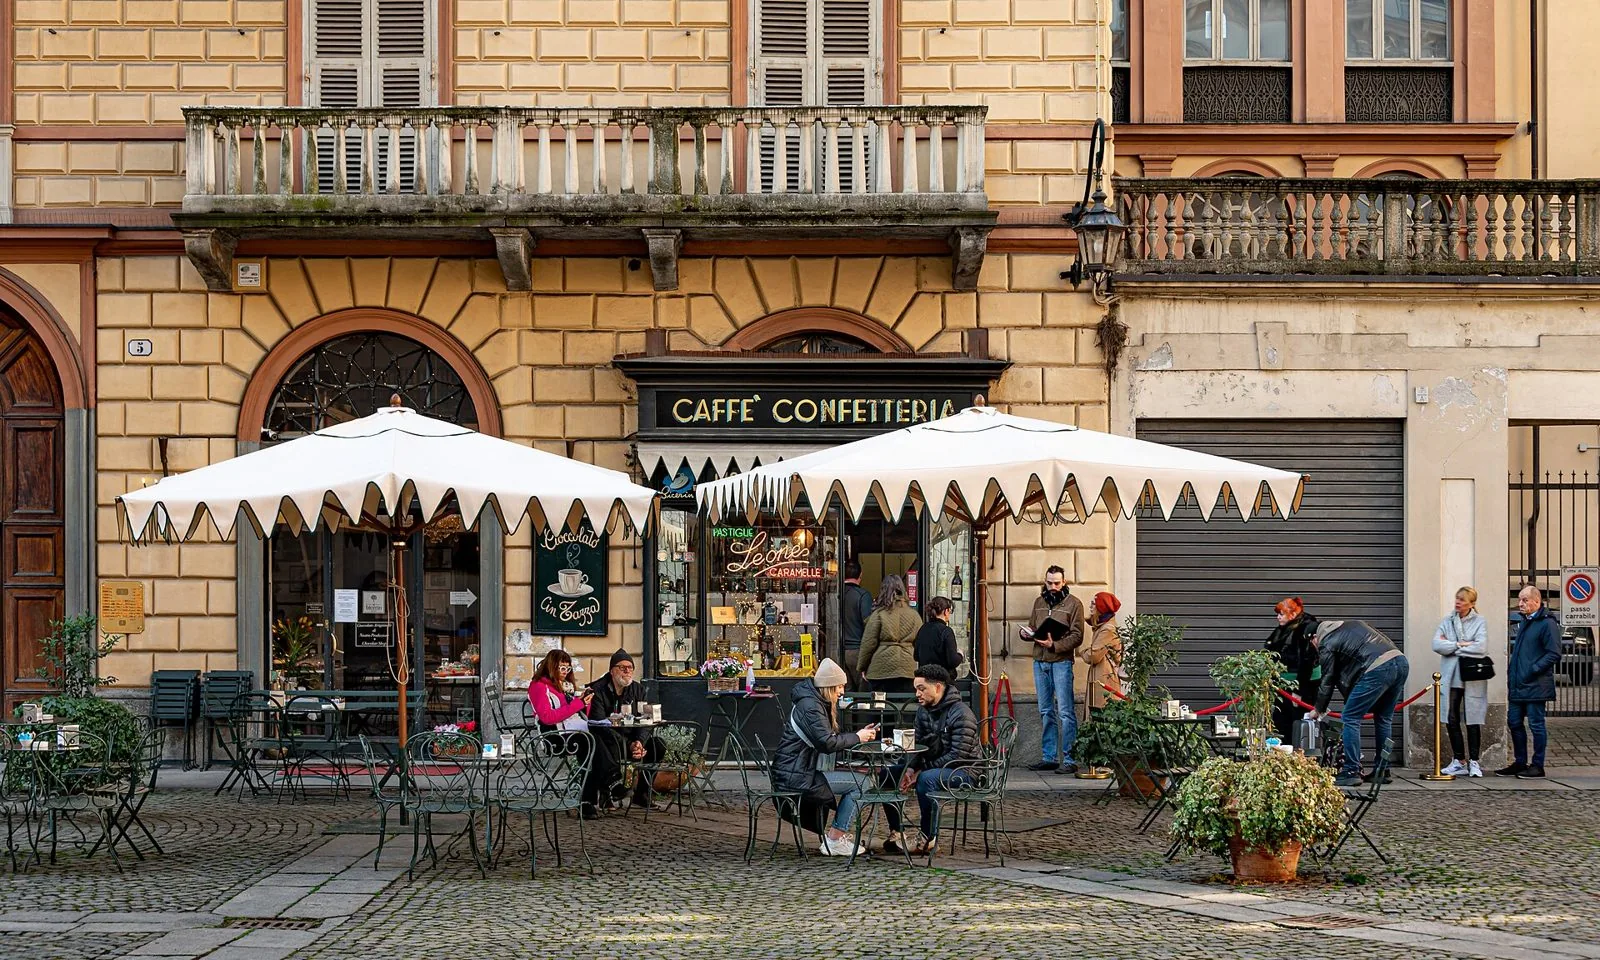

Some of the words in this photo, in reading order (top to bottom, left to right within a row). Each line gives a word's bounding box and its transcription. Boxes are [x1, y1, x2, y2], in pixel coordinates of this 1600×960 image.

[136, 341, 144, 354] 5
[771, 398, 956, 423] CONFETTERIA
[769, 567, 822, 578] CARAMELLE
[559, 596, 600, 627] Tazza
